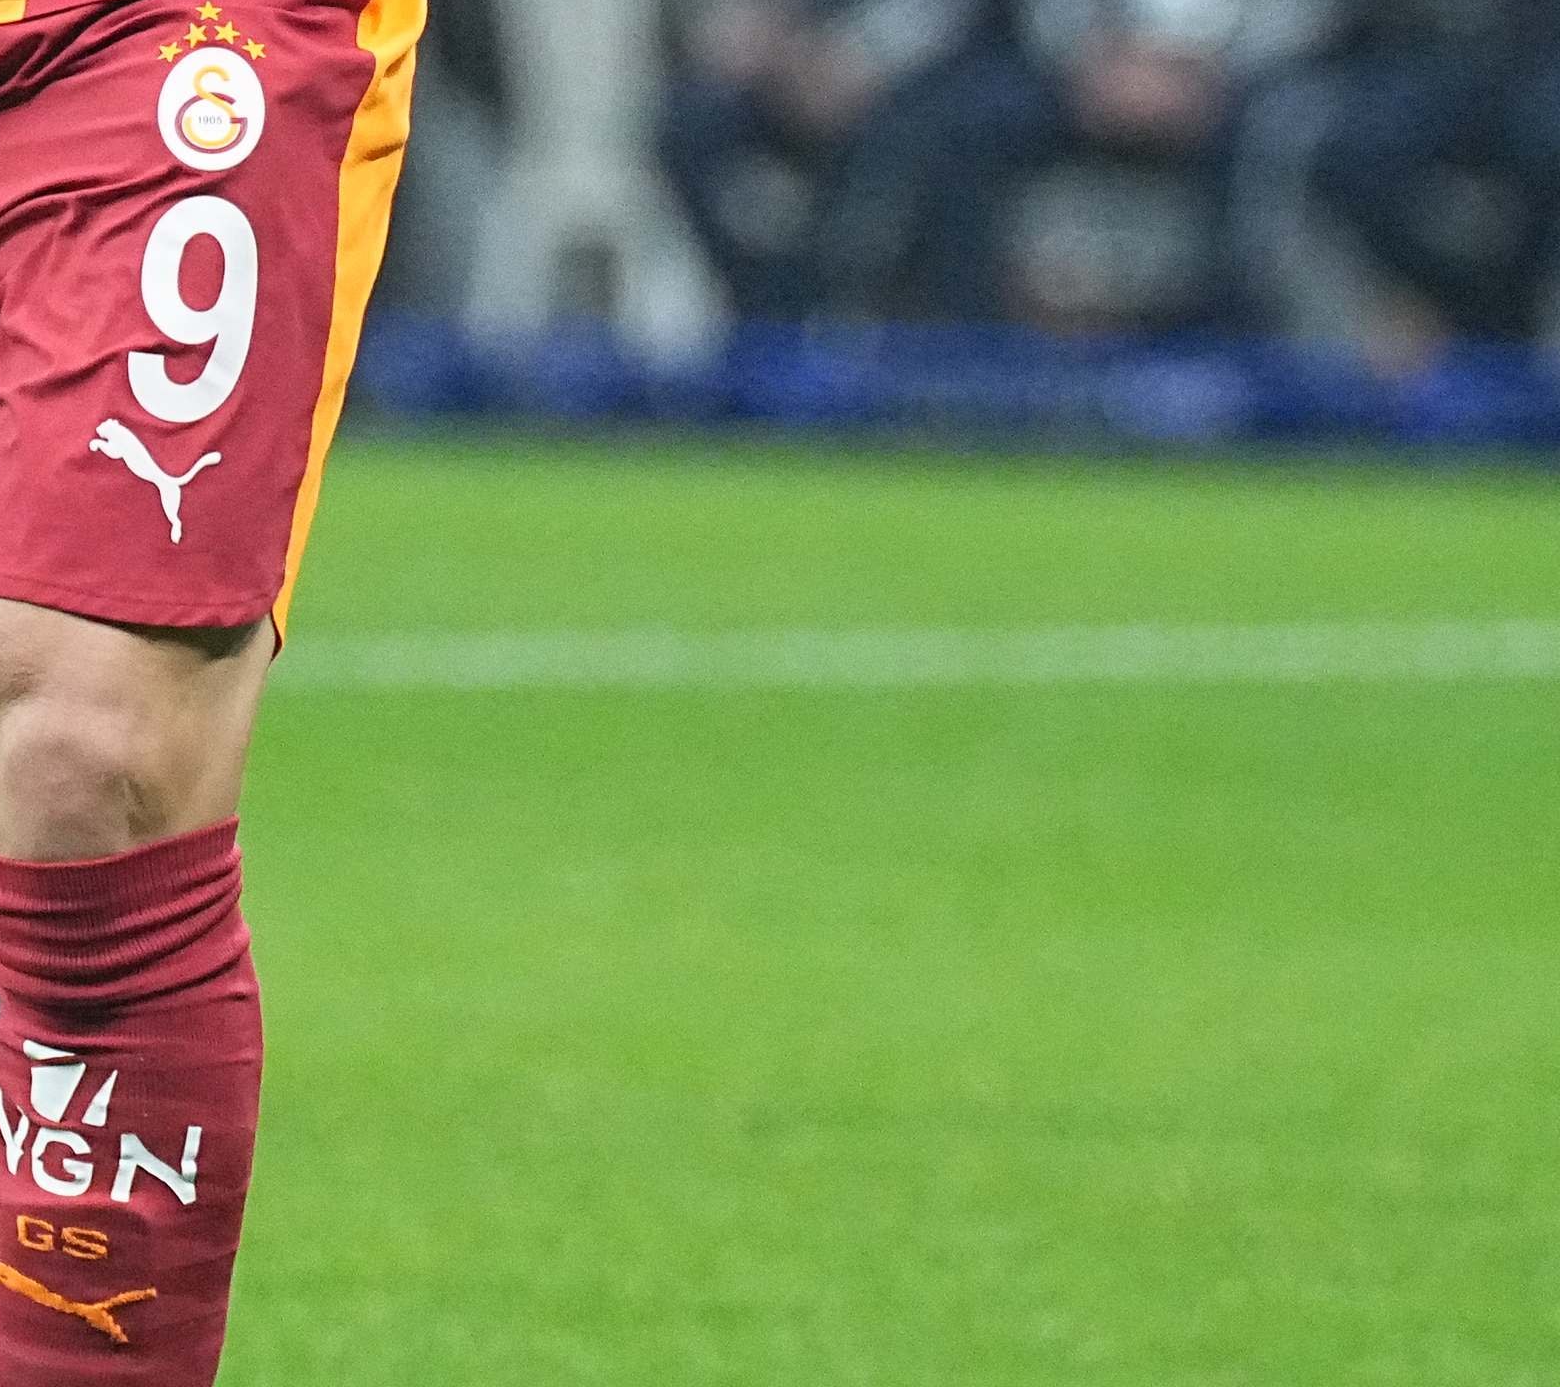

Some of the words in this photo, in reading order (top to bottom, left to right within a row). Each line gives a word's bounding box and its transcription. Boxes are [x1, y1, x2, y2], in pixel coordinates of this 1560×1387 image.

[197, 116, 223, 125] 1905
[126, 195, 259, 424] 9
[16, 1215, 109, 1261] GS
